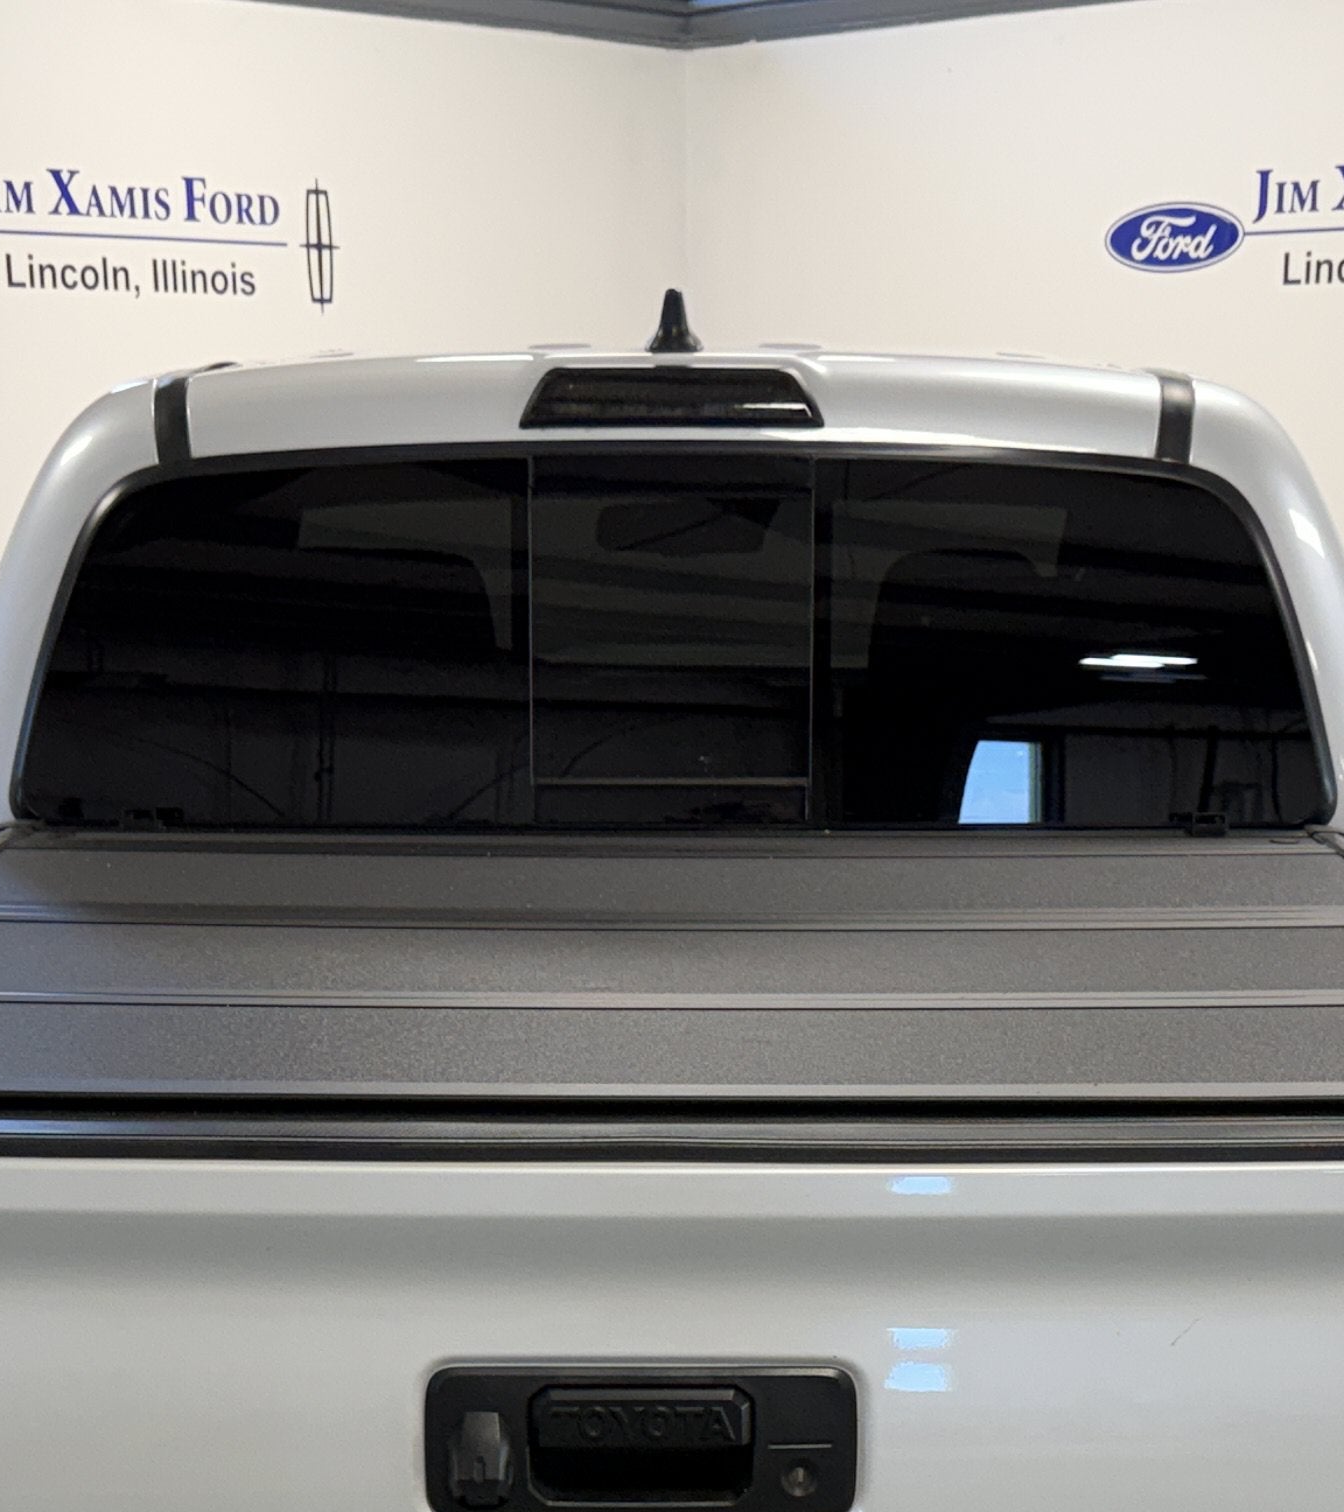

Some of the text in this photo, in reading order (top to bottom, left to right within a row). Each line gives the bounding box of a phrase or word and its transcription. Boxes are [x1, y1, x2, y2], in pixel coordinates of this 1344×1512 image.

[46, 168, 171, 222] XAMIS
[181, 176, 280, 226] FORD
[1253, 169, 1320, 223] JIM
[1130, 215, 1215, 262] Ford
[5, 253, 256, 298] Lincoln, Illinois
[547, 1405, 736, 1439] TOYOTA
